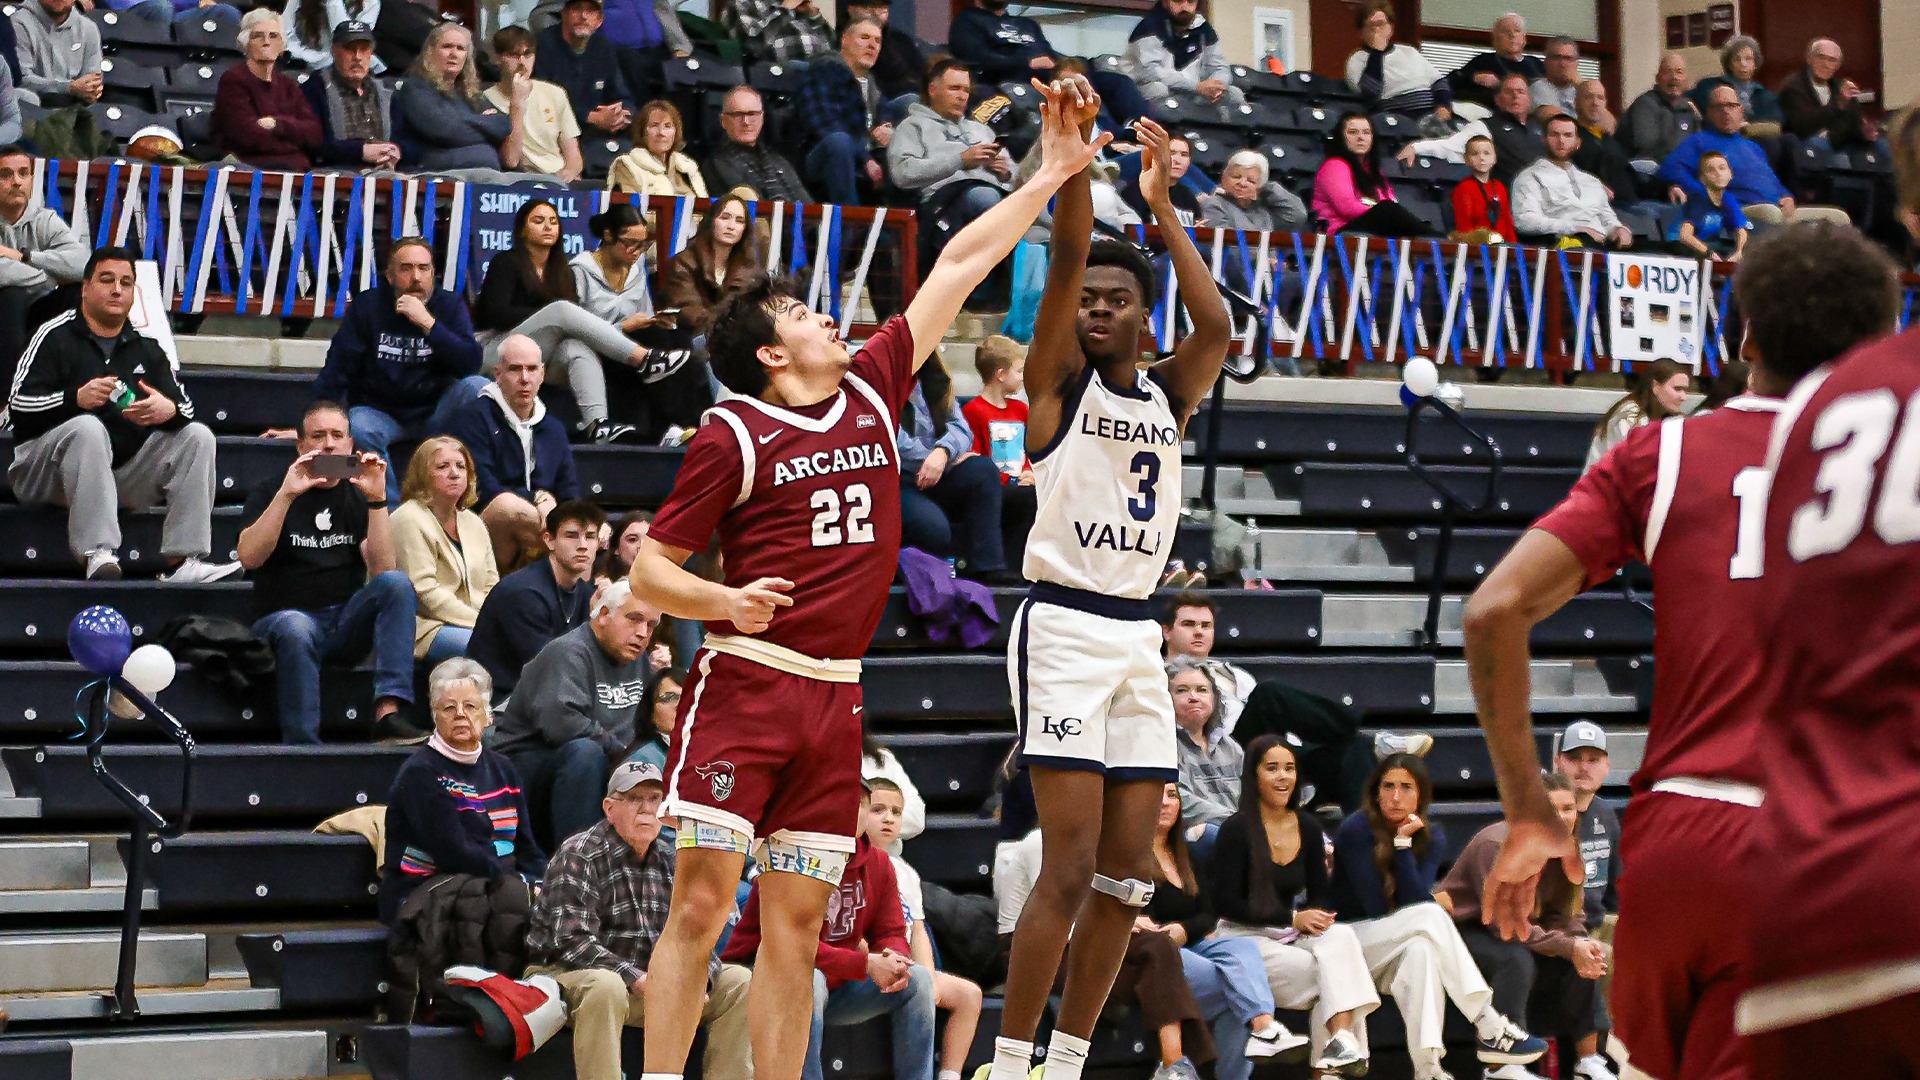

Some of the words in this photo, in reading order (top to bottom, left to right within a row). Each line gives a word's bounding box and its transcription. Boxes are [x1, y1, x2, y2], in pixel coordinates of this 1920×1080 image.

[479, 229, 513, 251] THE
[773, 443, 889, 486] ARCADIA
[1128, 450, 1161, 522] 3
[810, 483, 875, 547] 22
[290, 533, 318, 548] Think
[1074, 521, 1161, 556] VALL
[1042, 715, 1082, 742] LVC
